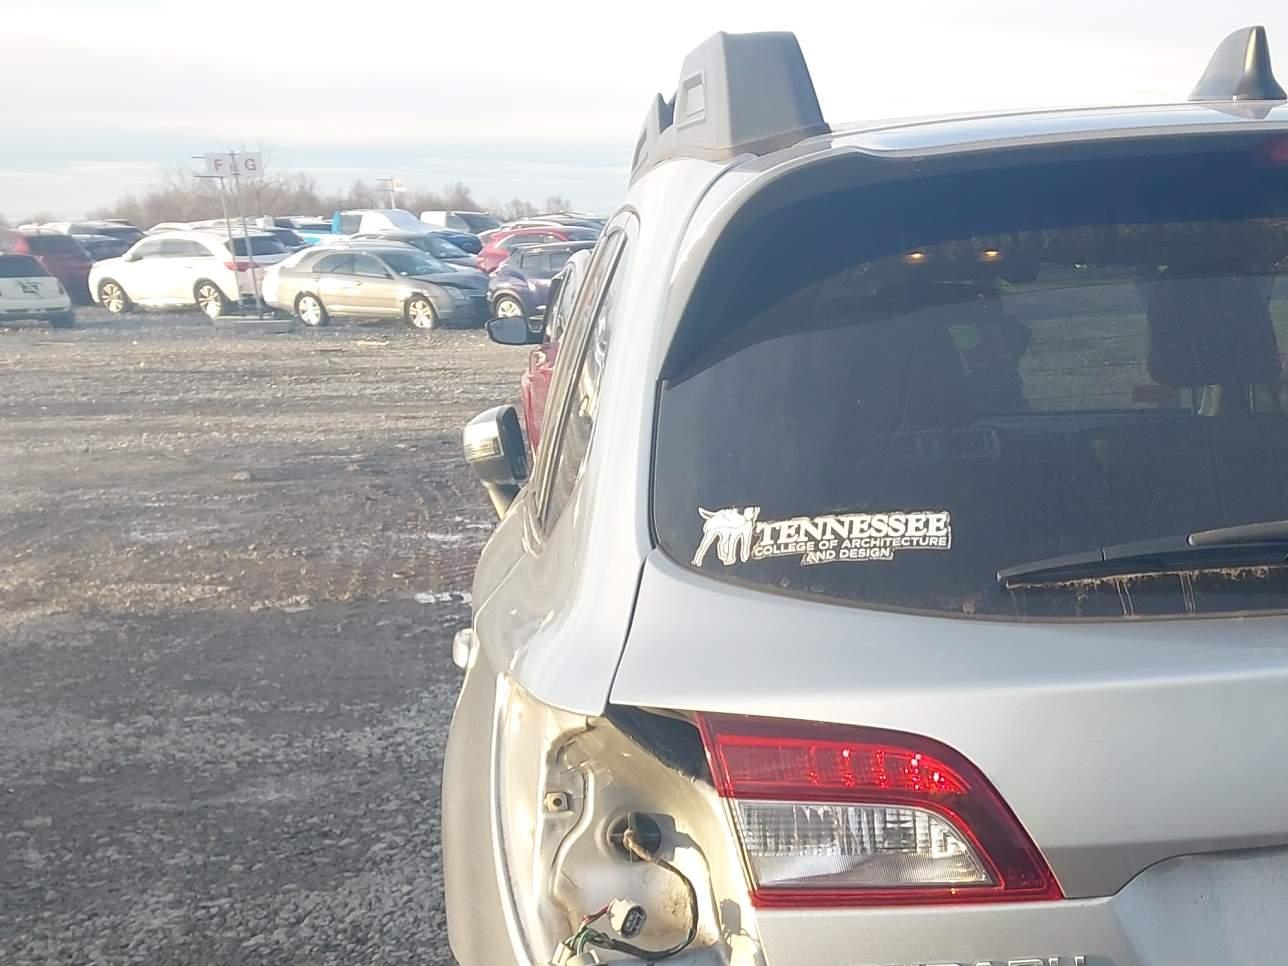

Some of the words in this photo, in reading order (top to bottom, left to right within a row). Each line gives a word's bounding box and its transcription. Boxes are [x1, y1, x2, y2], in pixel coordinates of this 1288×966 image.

[213, 159, 223, 171] F
[244, 158, 257, 171] G
[755, 513, 948, 546] TENNESSEE
[755, 541, 815, 557] COLLEGE
[818, 539, 839, 550] OF
[841, 536, 948, 549] ARCHITECTURE
[806, 550, 837, 565] AND
[839, 547, 891, 559] DESIGN
